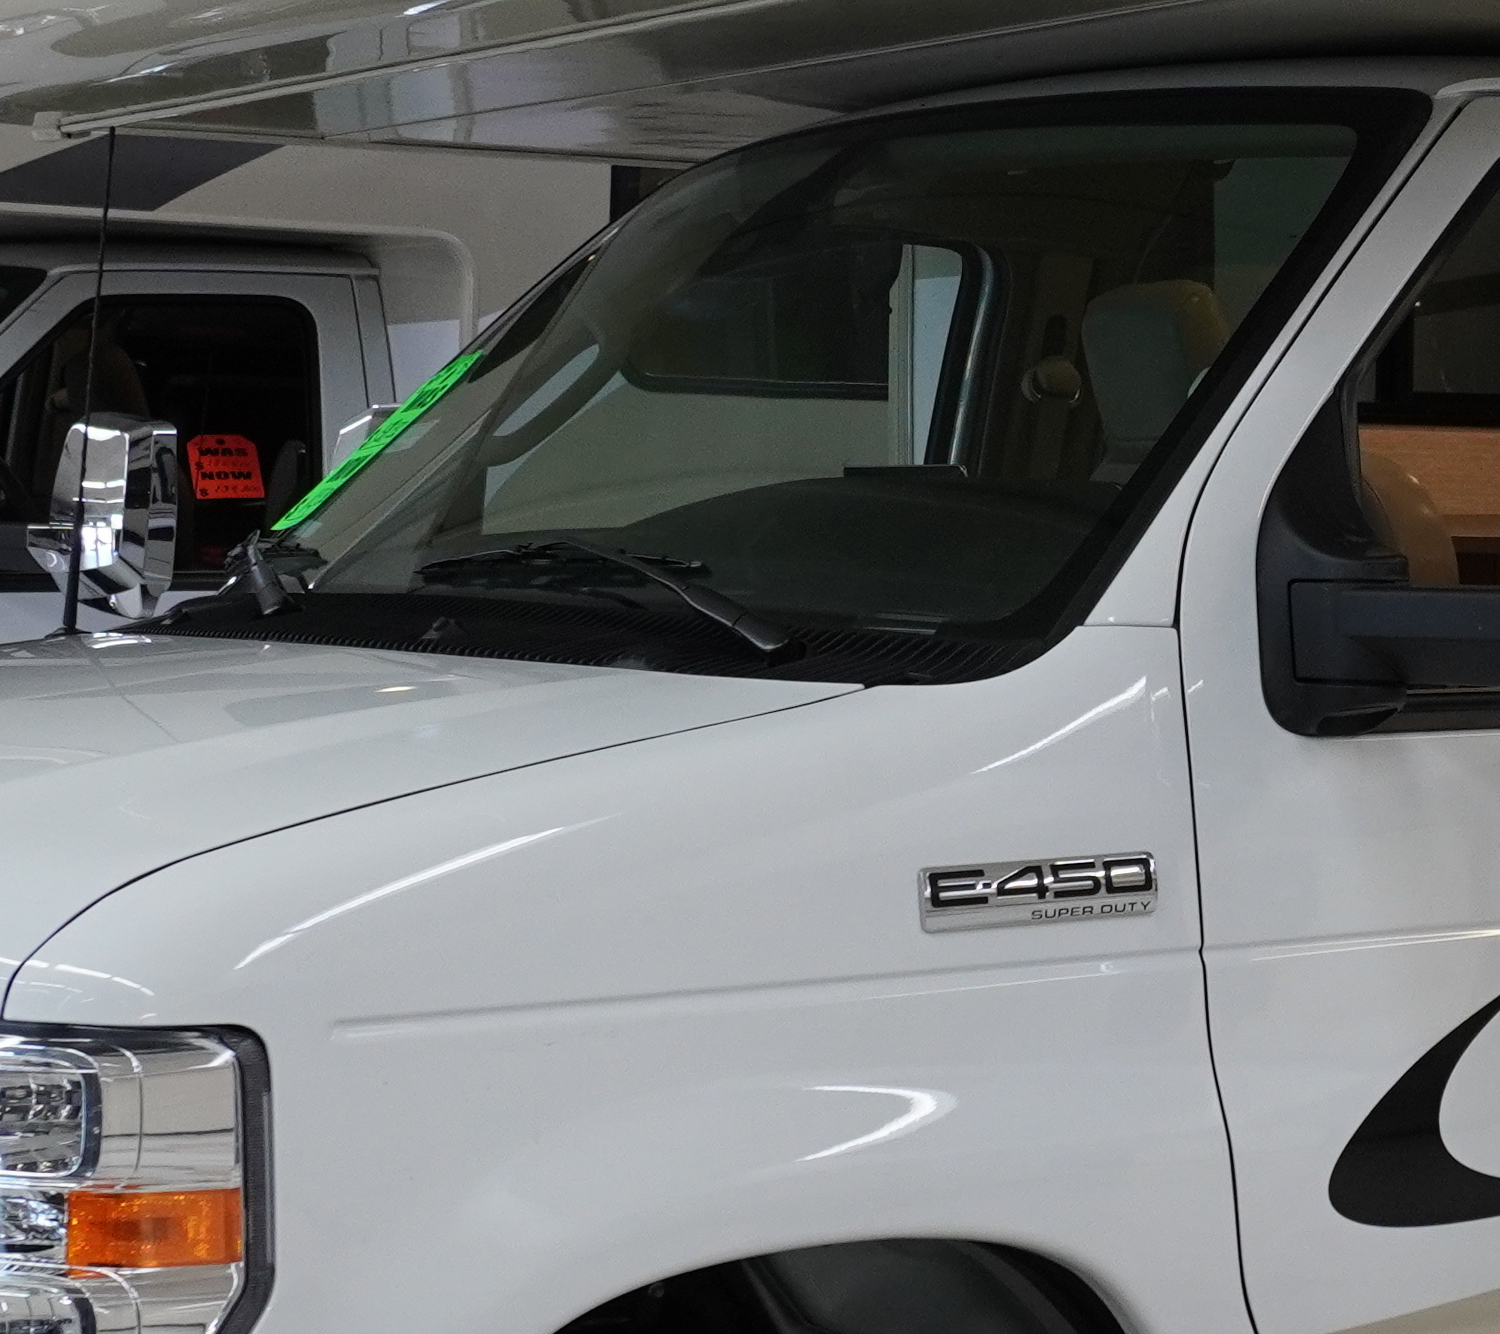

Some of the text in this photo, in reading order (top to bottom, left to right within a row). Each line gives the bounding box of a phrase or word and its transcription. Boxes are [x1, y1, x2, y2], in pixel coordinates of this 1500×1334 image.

[200, 471, 253, 480] NOW
[1031, 900, 1152, 921] SUPER DUTY
